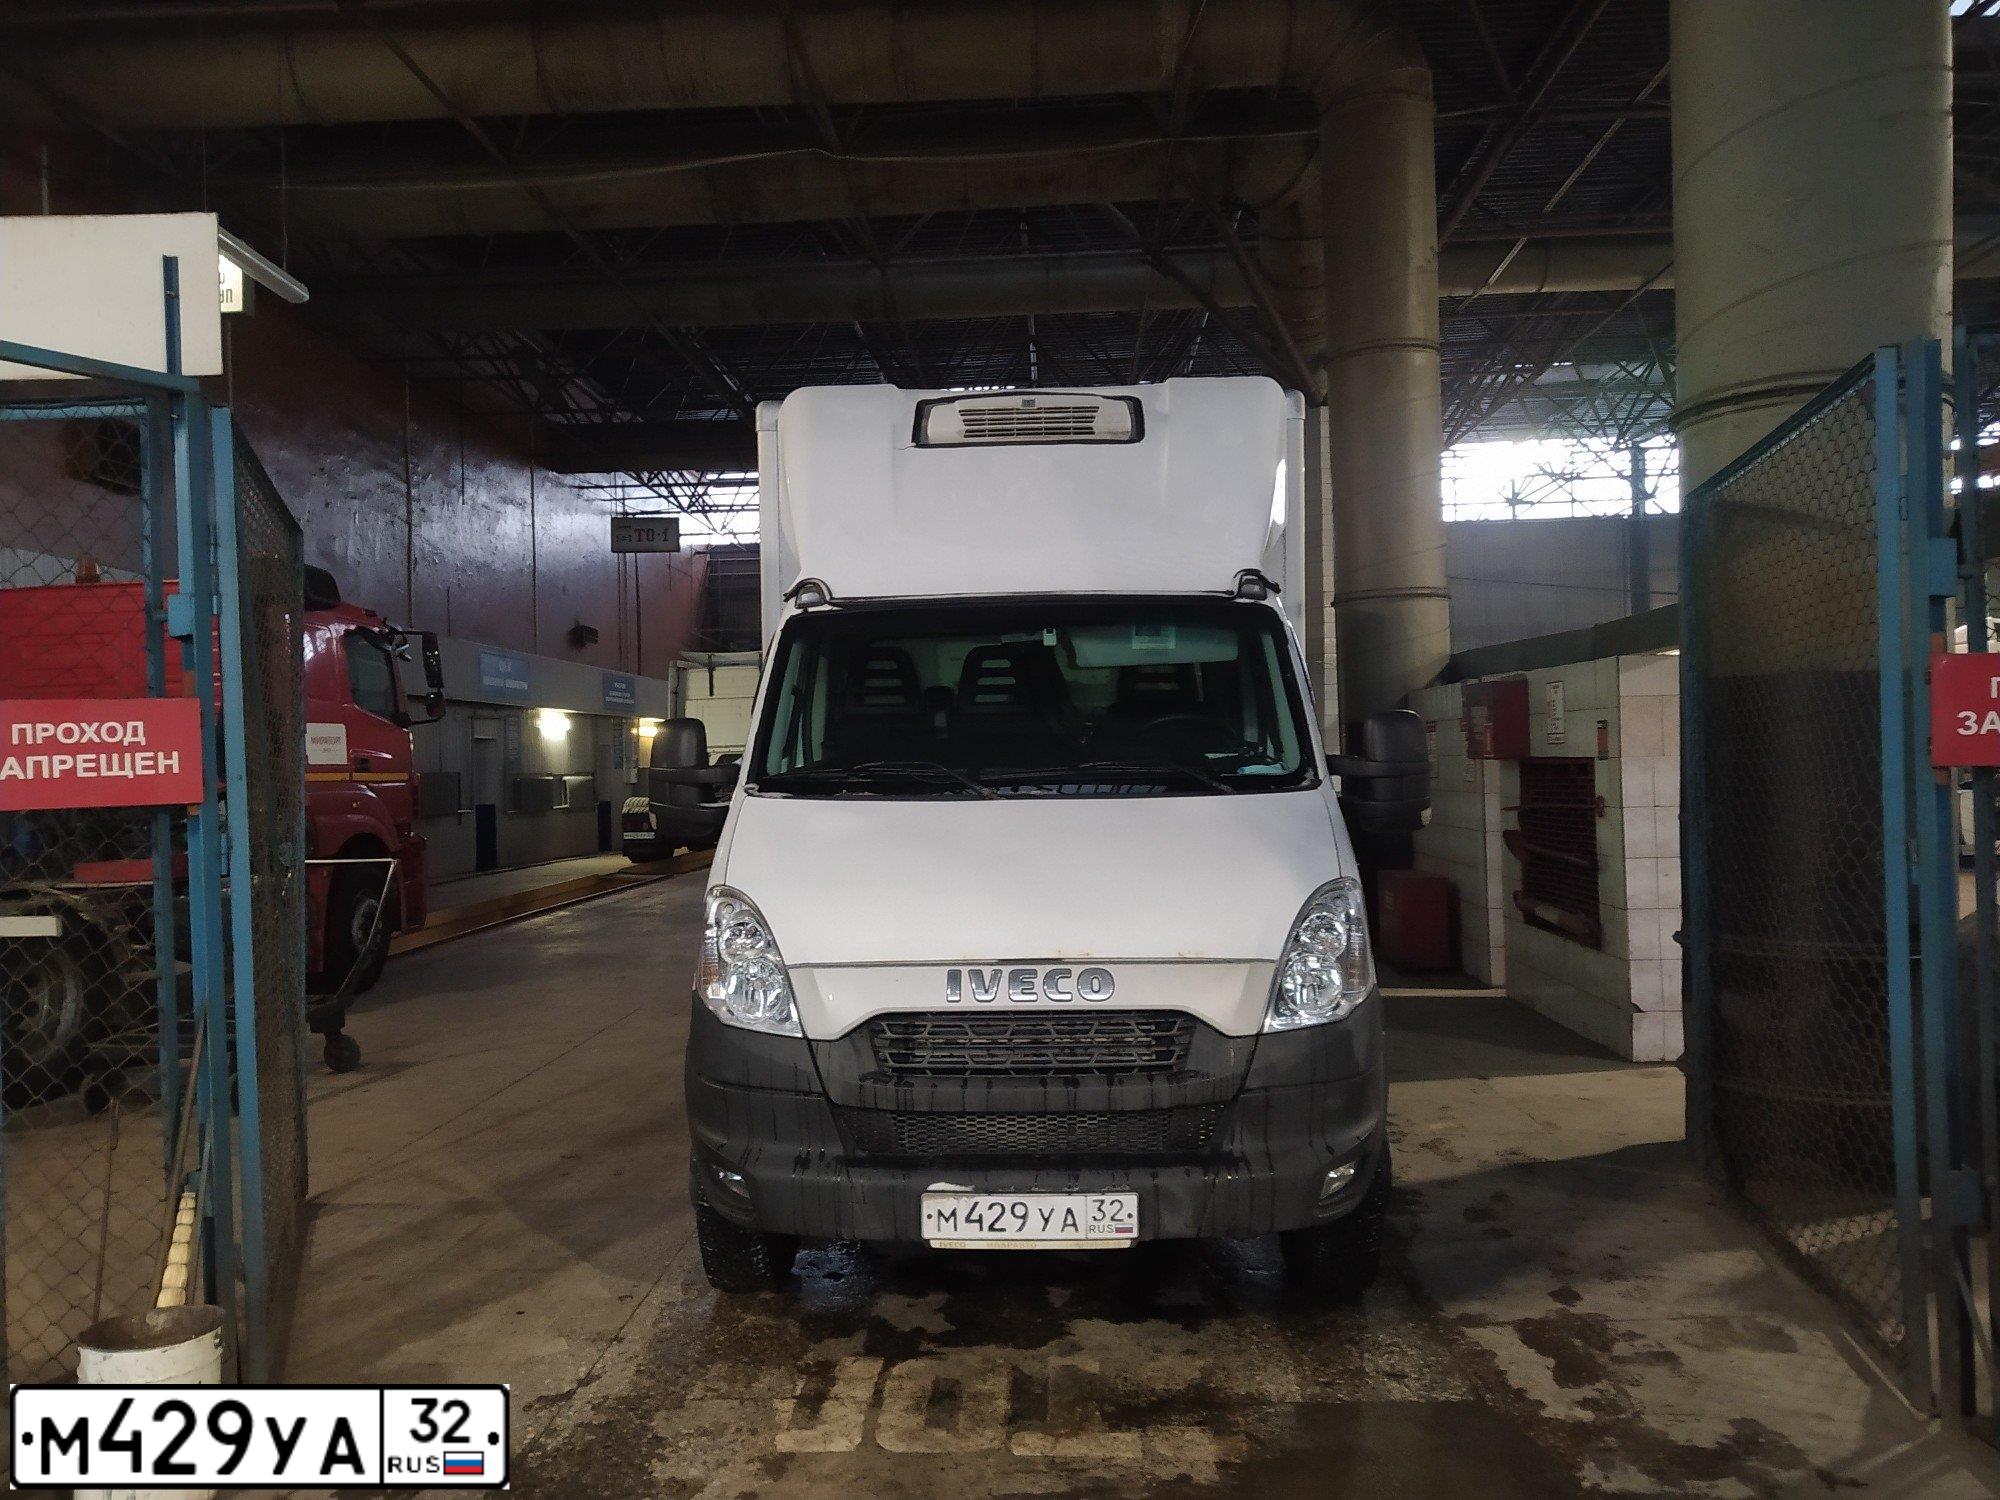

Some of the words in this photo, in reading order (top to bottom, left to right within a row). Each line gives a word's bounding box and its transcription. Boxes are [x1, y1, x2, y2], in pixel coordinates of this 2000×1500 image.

[11, 721, 147, 747] ПРОХОД
[0, 751, 180, 780] АПРЕЩЕН
[946, 967, 1115, 1002] IVECO
[937, 1201, 1079, 1233] М429УА
[1091, 1199, 1125, 1222] 32
[1088, 1224, 1114, 1234] RUS
